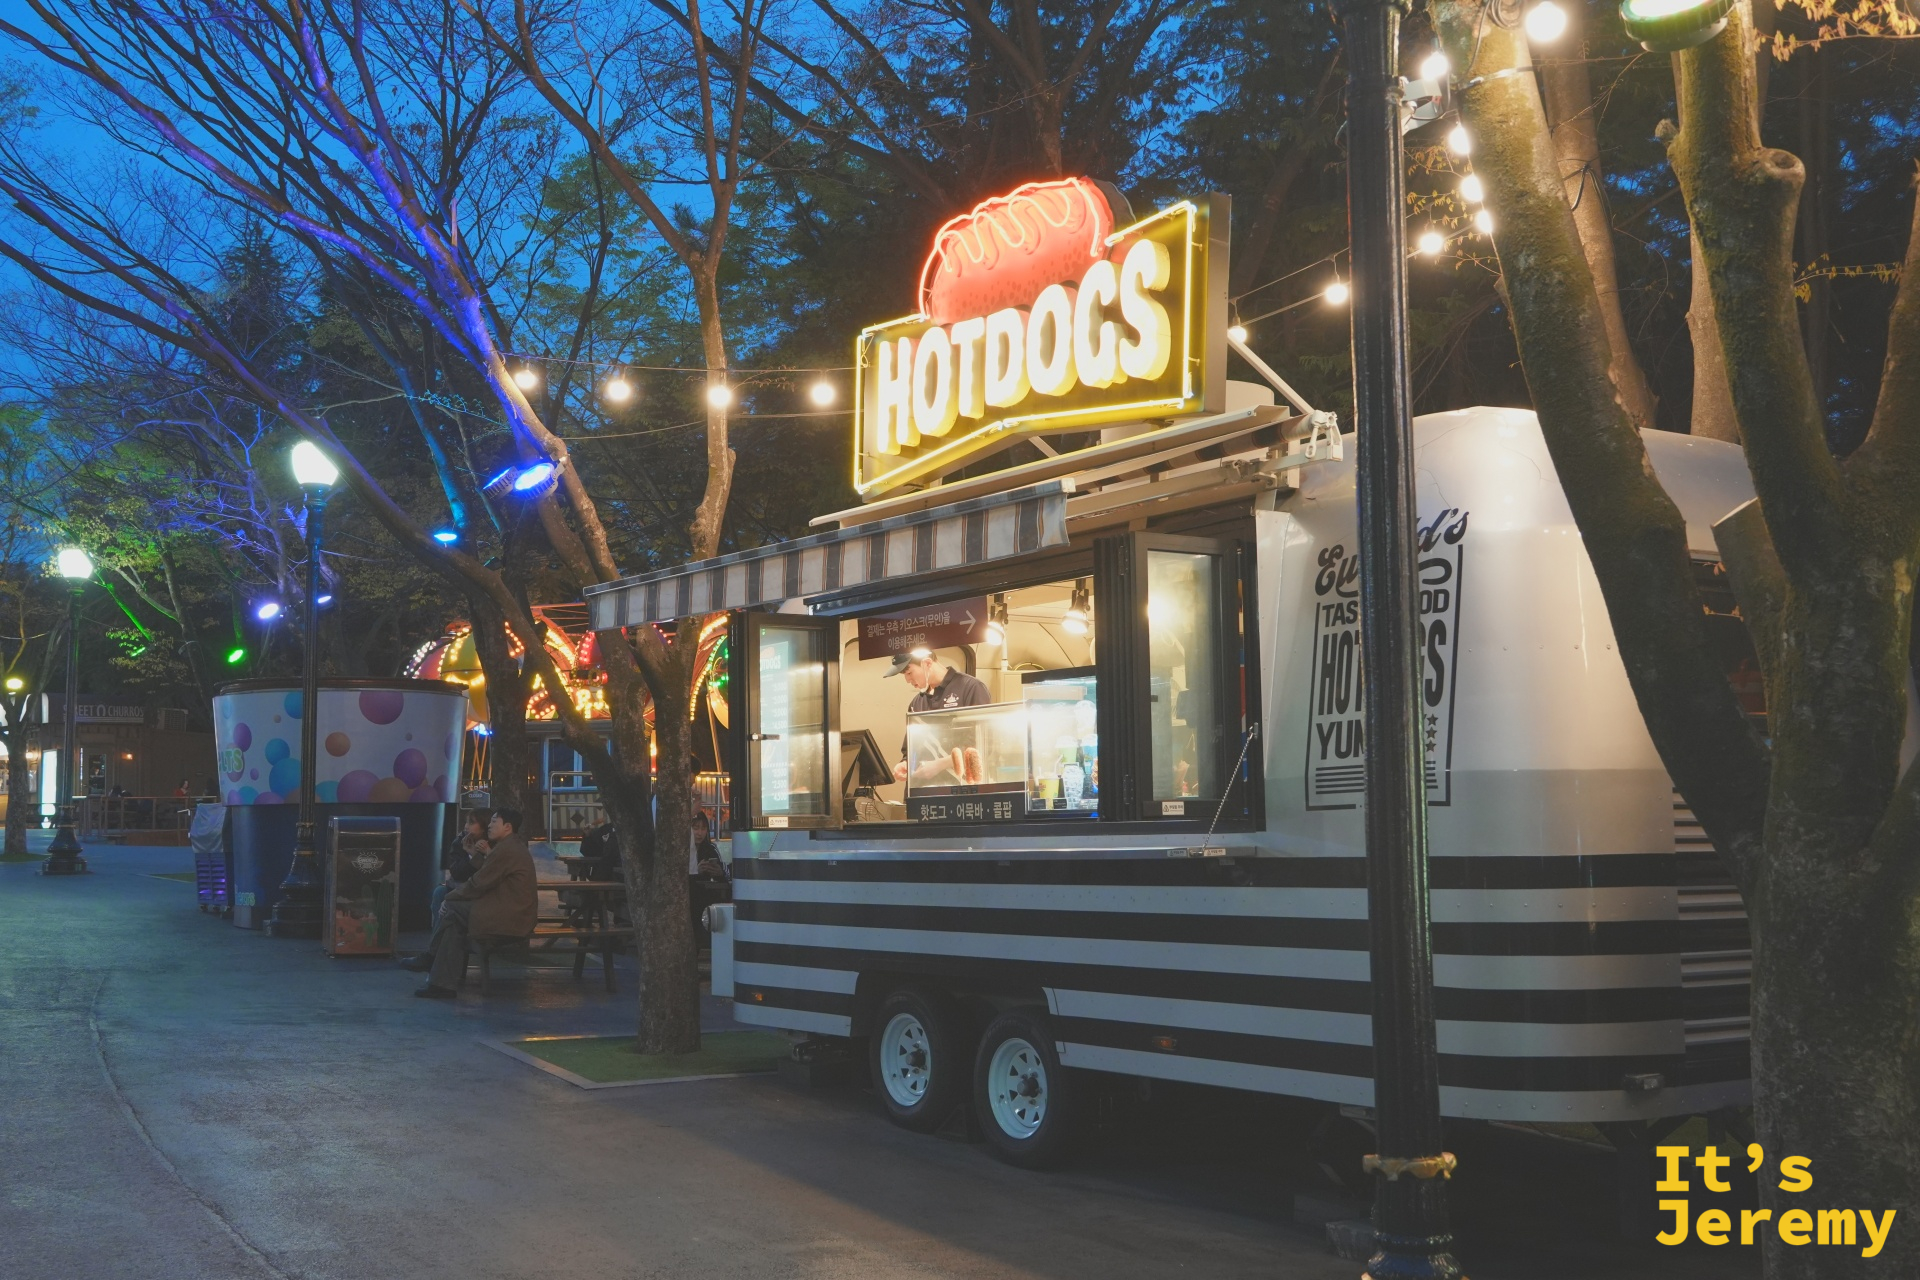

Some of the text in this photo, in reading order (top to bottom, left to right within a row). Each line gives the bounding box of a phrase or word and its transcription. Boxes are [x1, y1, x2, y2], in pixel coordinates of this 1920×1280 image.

[877, 239, 1170, 455] HOTDOGS
[867, 611, 950, 638] 결제는 우측 키오스크(무인)을
[63, 705, 144, 717] SREET CHURROS
[920, 805, 947, 821] 핫도그
[956, 802, 983, 820] 어묵바
[993, 800, 1012, 819] 콜팝
